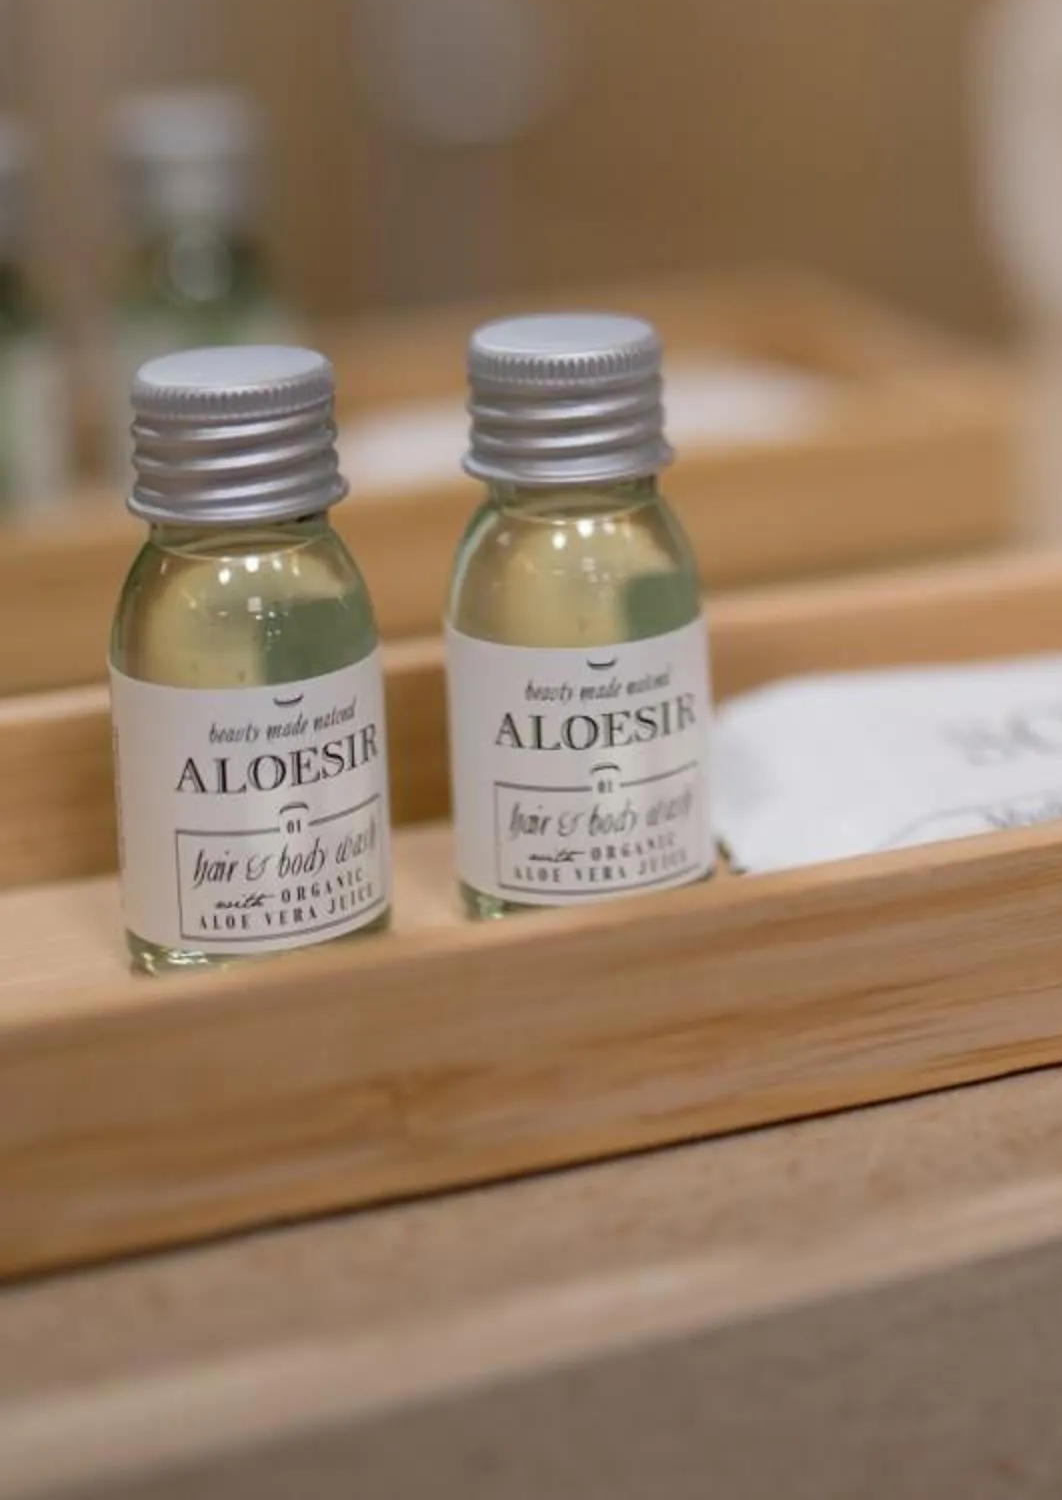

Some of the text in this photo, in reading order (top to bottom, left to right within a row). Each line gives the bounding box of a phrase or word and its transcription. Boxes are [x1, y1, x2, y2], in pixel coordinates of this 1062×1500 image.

[525, 679, 574, 704] beauty
[579, 676, 622, 702] made
[209, 722, 259, 745] beauty
[266, 713, 307, 742] made
[494, 691, 697, 751] ALOESIR
[174, 722, 379, 794] ALOESIR
[508, 802, 551, 841] hair
[588, 797, 637, 838] body
[193, 849, 239, 890] hair
[278, 837, 327, 879] body
[591, 831, 677, 861] ORGANIC
[215, 867, 365, 911] with ORGANIC
[514, 865, 562, 884] ALOE
[574, 864, 627, 883] VERA
[200, 883, 374, 931] ALOE VERA JUICE
